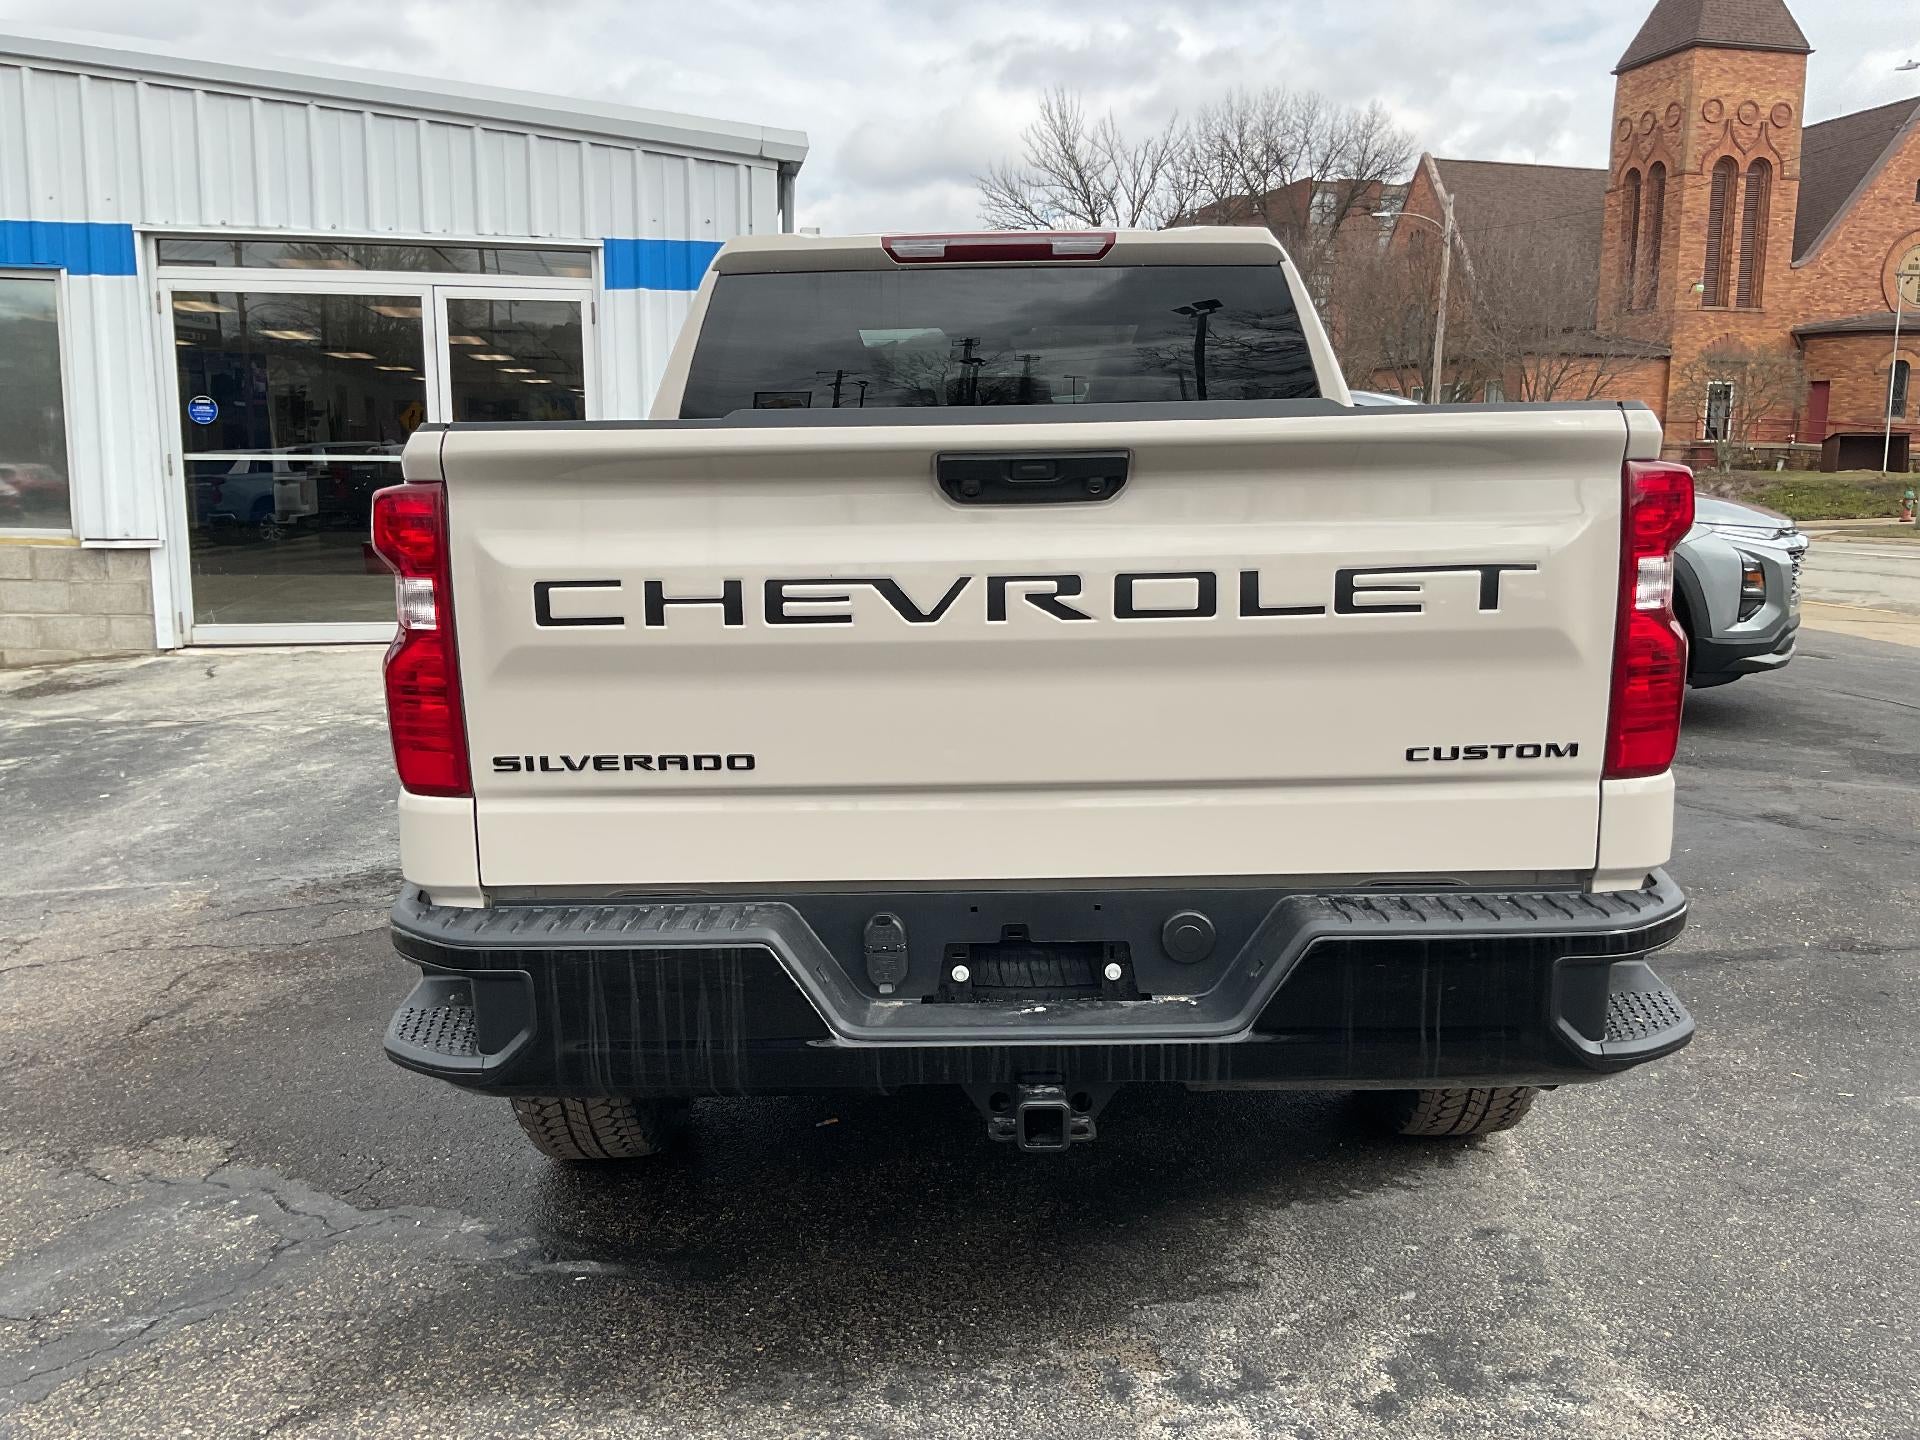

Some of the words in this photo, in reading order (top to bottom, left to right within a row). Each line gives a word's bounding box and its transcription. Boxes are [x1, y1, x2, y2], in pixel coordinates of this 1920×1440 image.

[534, 564, 1538, 627] CHEVROLET
[1405, 742, 1579, 762] CUSTOM
[493, 753, 756, 773] SILVERADO
